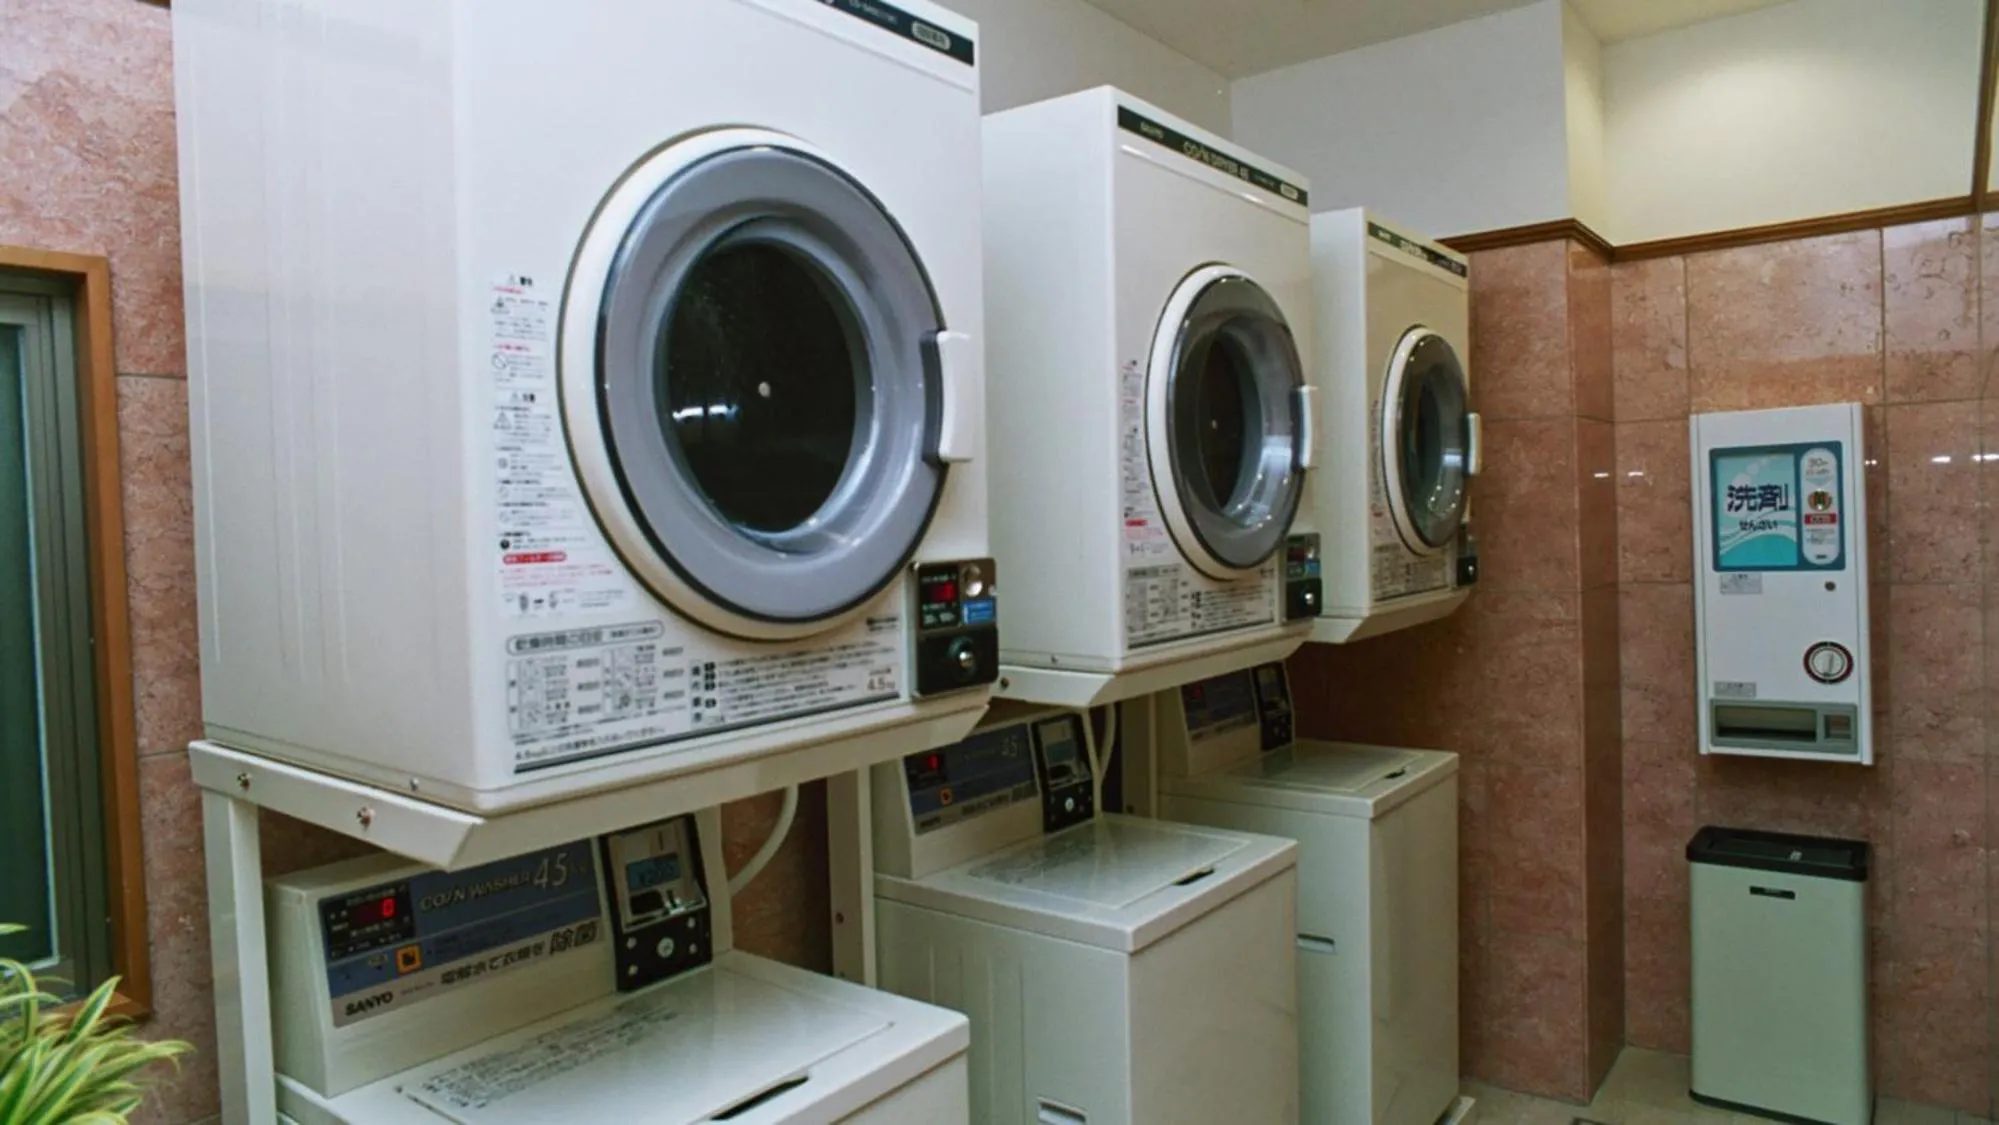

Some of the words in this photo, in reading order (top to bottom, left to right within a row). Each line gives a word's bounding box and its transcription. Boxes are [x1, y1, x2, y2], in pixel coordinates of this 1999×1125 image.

[1727, 482, 1789, 512] 洗剤
[534, 852, 569, 889] 45
[344, 990, 395, 1017] SANYO
